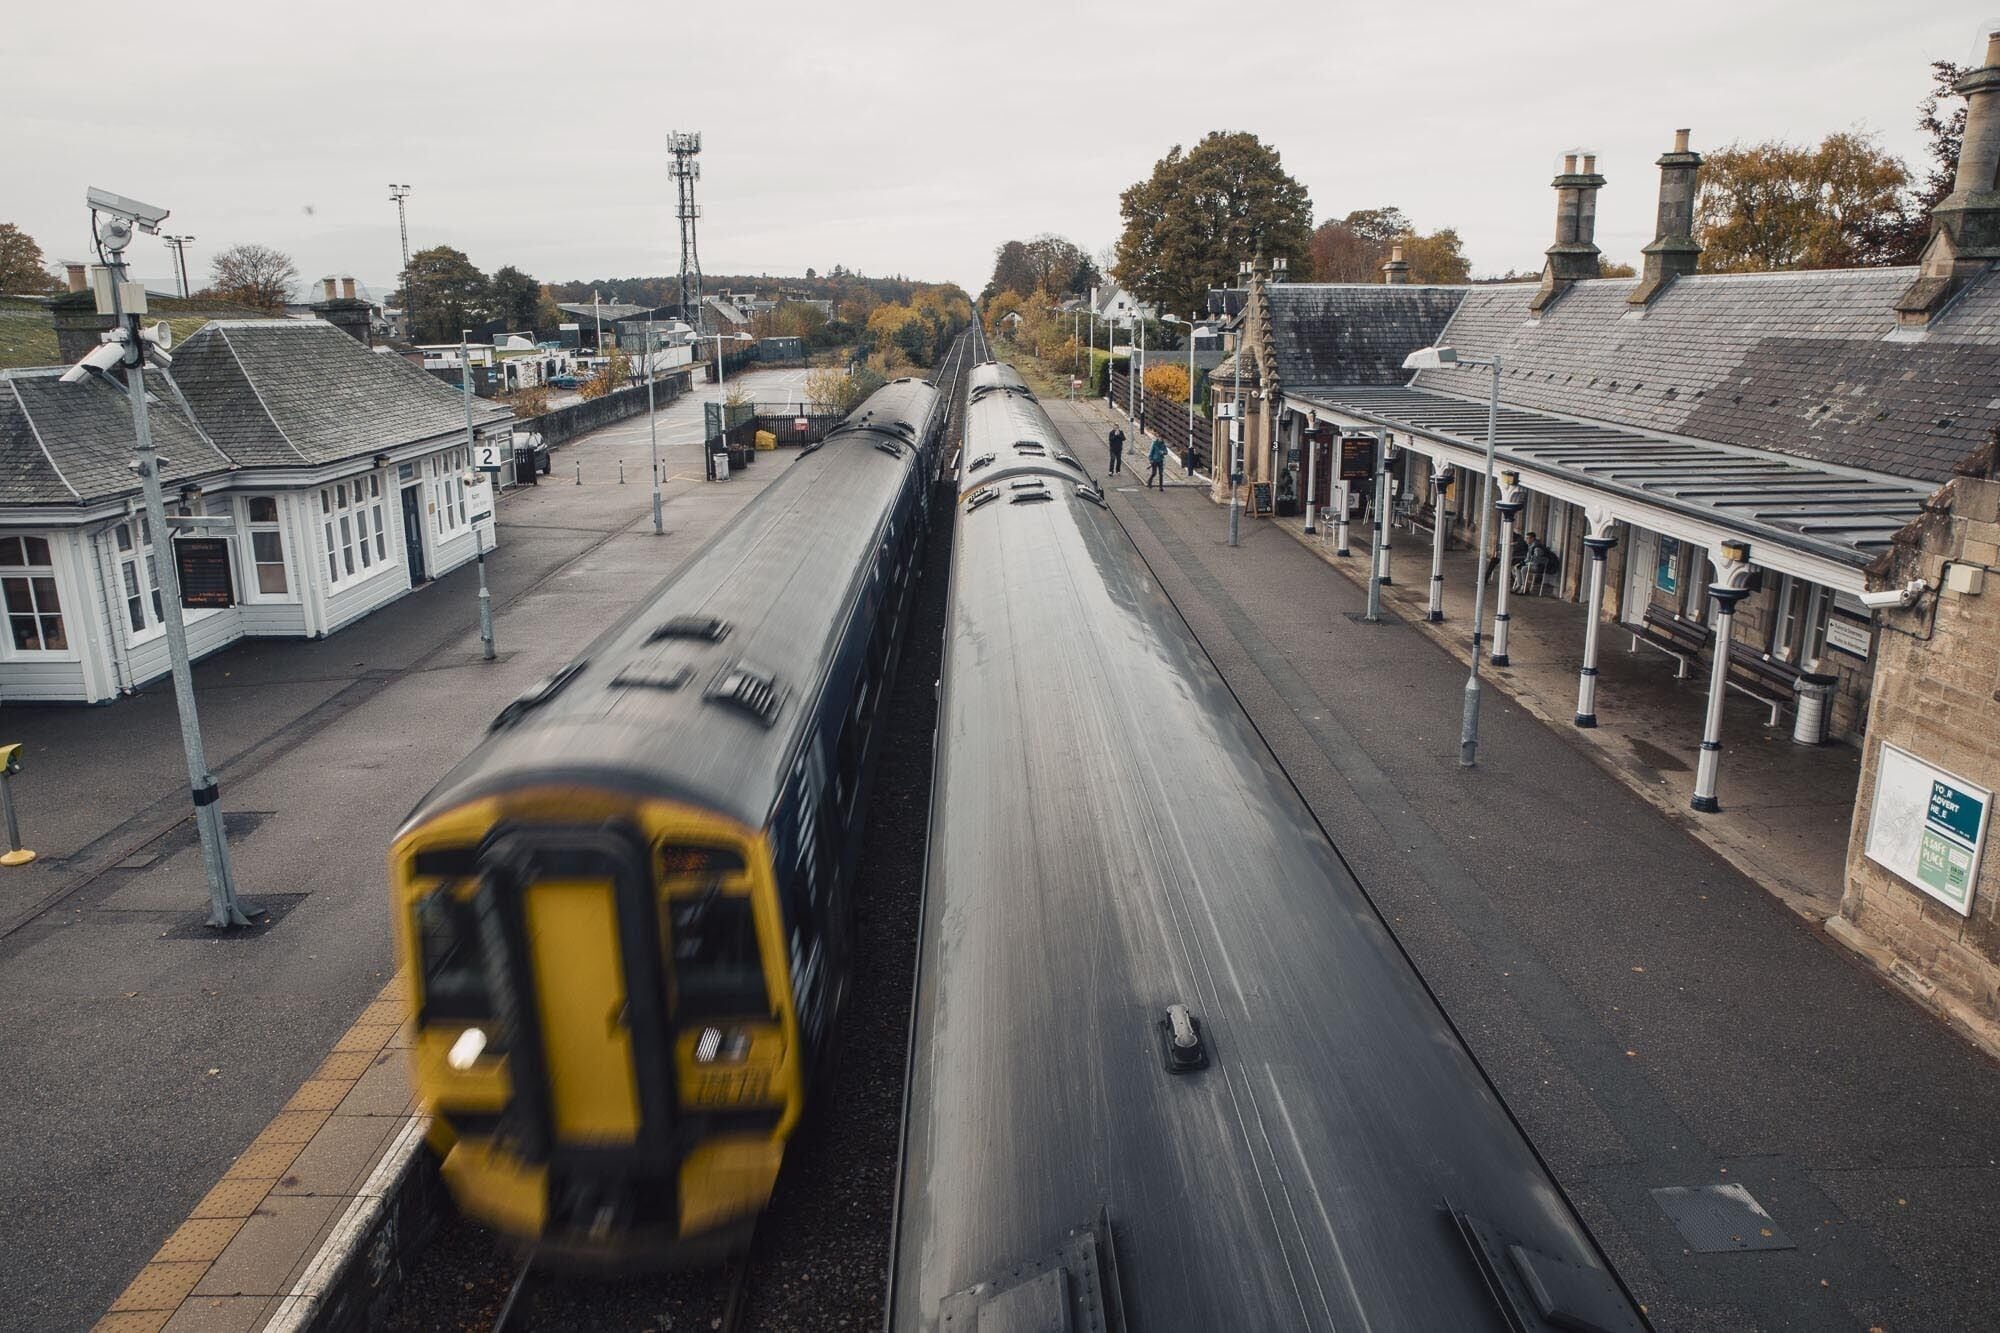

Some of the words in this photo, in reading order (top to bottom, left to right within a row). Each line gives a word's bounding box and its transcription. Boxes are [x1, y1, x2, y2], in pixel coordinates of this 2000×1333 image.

[1223, 404, 1229, 415] 1
[1272, 441, 1279, 449] 3
[482, 448, 493, 465] 2
[1932, 794, 1960, 813] ADVERT
[1922, 847, 1945, 868] PLACE
